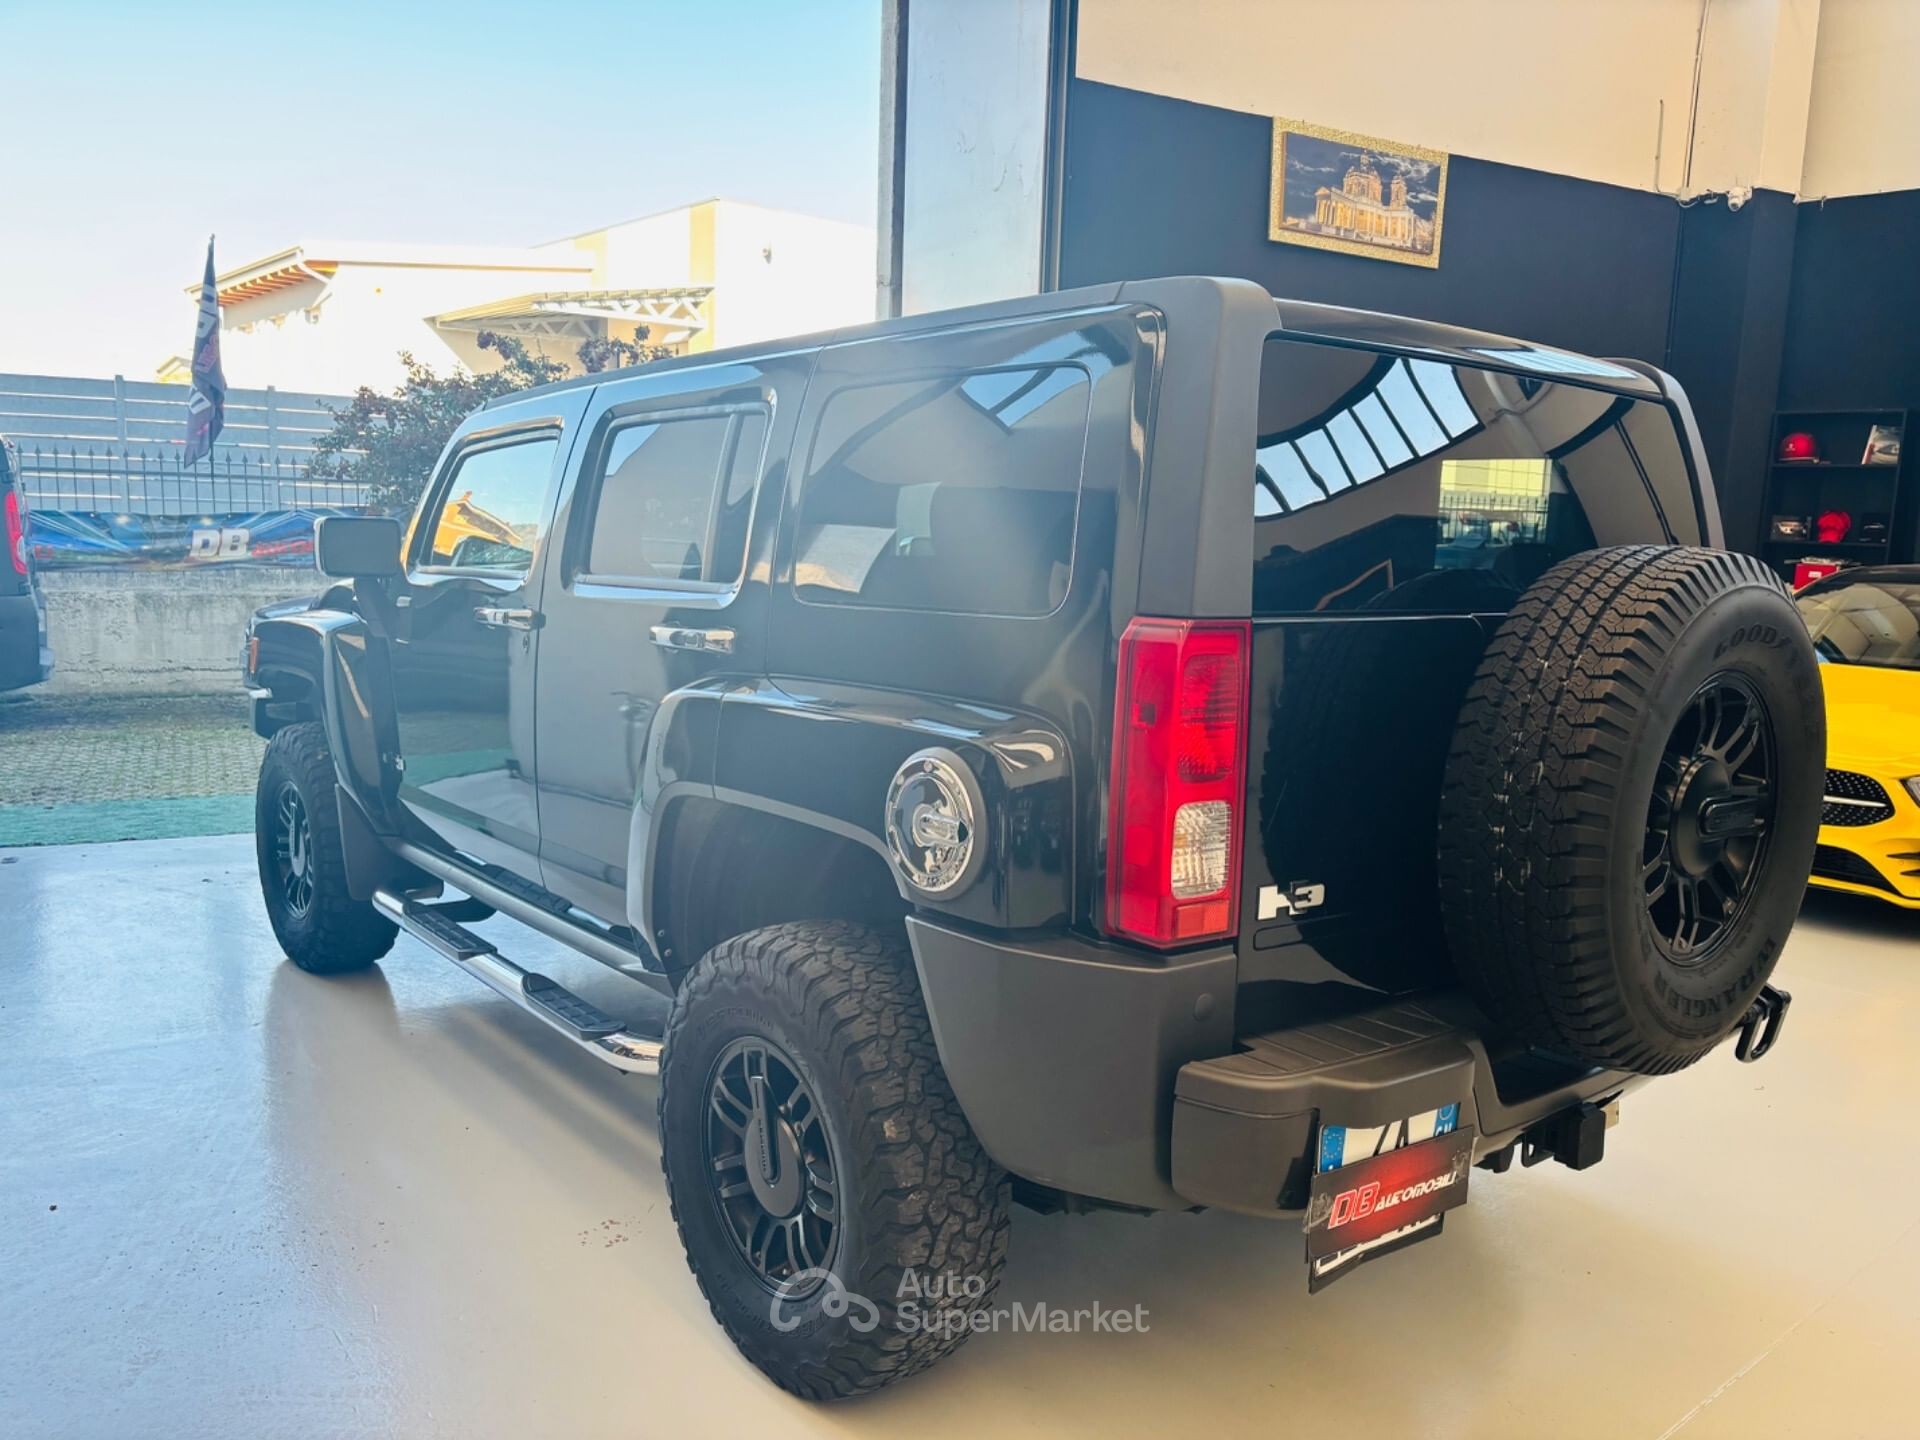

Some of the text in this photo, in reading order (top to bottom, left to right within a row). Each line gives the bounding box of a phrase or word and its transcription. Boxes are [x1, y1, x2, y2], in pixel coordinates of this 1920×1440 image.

[190, 527, 251, 558] DB
[1257, 884, 1325, 920] H3
[1327, 1181, 1381, 1230] DB
